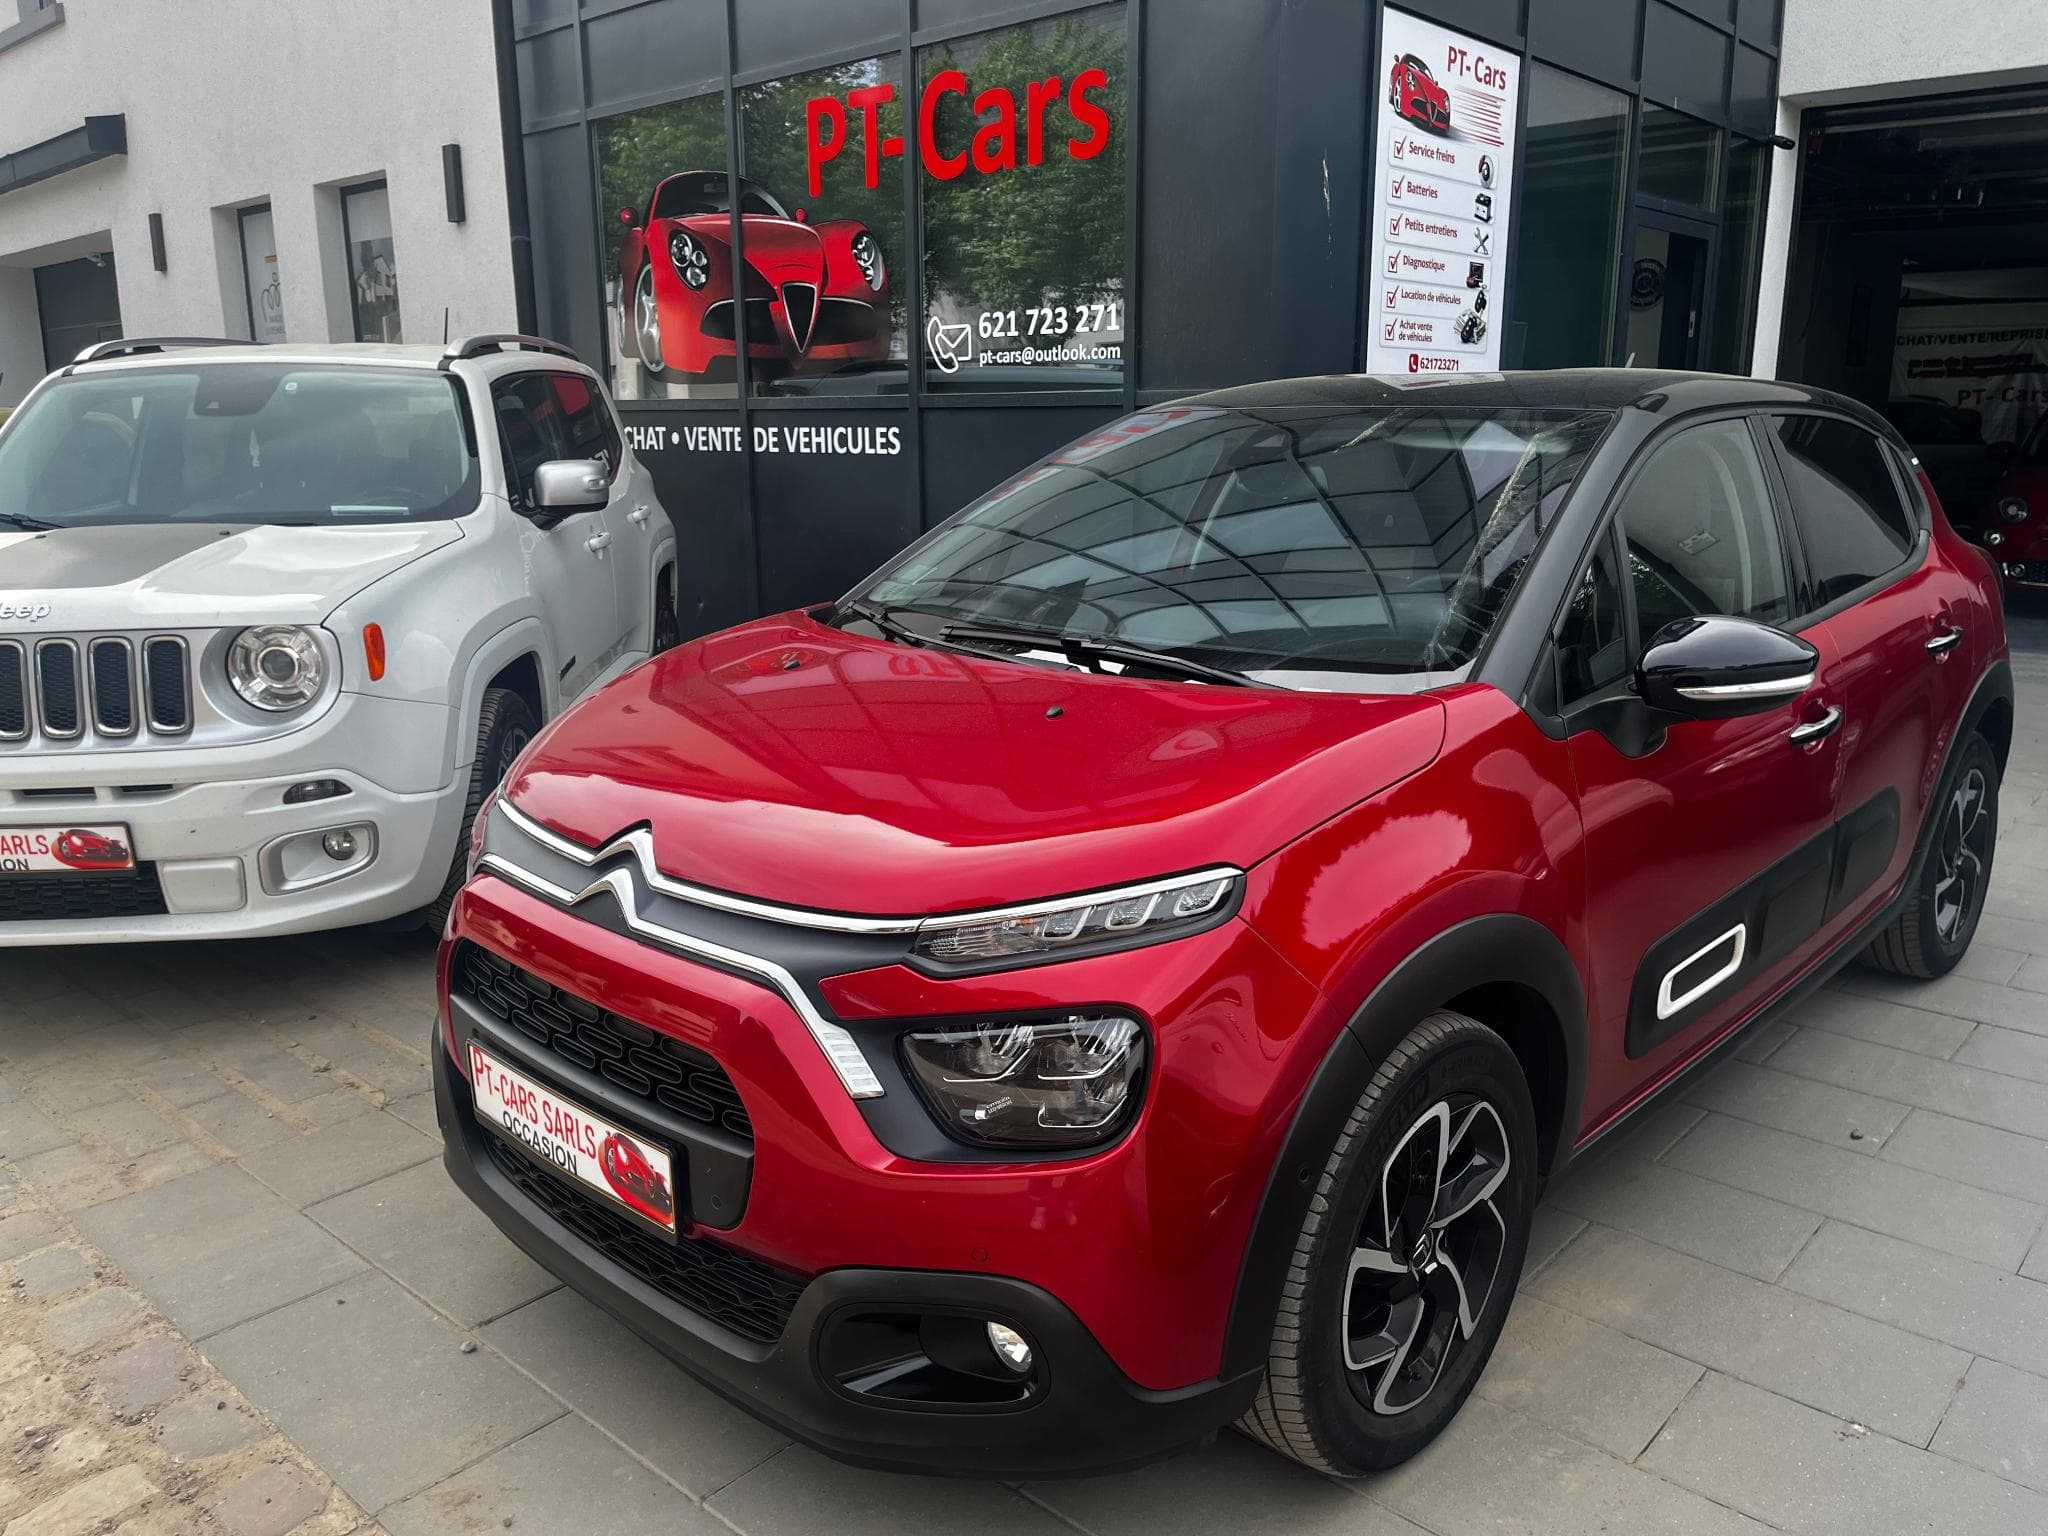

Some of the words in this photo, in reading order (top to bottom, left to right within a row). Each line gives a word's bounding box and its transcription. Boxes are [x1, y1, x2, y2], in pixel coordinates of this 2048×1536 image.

[1474, 56, 1507, 90] Cars
[1408, 141, 1435, 160] Service
[1436, 148, 1456, 165] freins
[1407, 181, 1438, 199] Batteries
[1405, 217, 1425, 233] Petits
[1425, 224, 1458, 238] entretiens
[1403, 255, 1446, 273] Diagnostique
[1401, 288, 1427, 300] Location
[1427, 292, 1435, 302] de
[979, 311, 1019, 339] 621
[1025, 306, 1069, 336] 723
[1075, 303, 1120, 333] 271
[1399, 320, 1417, 332] Achat
[1417, 322, 1433, 332] vente
[1398, 332, 1407, 341] de
[979, 343, 1121, 368] pt-cars@outlook.com
[1420, 357, 1460, 371] 621723271
[624, 426, 667, 451] CHAT
[683, 426, 742, 452] VENTE
[753, 426, 779, 453] DE
[783, 426, 901, 455] VEHICULES
[0, 601, 51, 623] eep
[0, 834, 50, 856] ARLS
[472, 1045, 538, 1125] PT-CARS
[542, 1099, 597, 1160] SARLS
[502, 1110, 578, 1176] OCCASION
